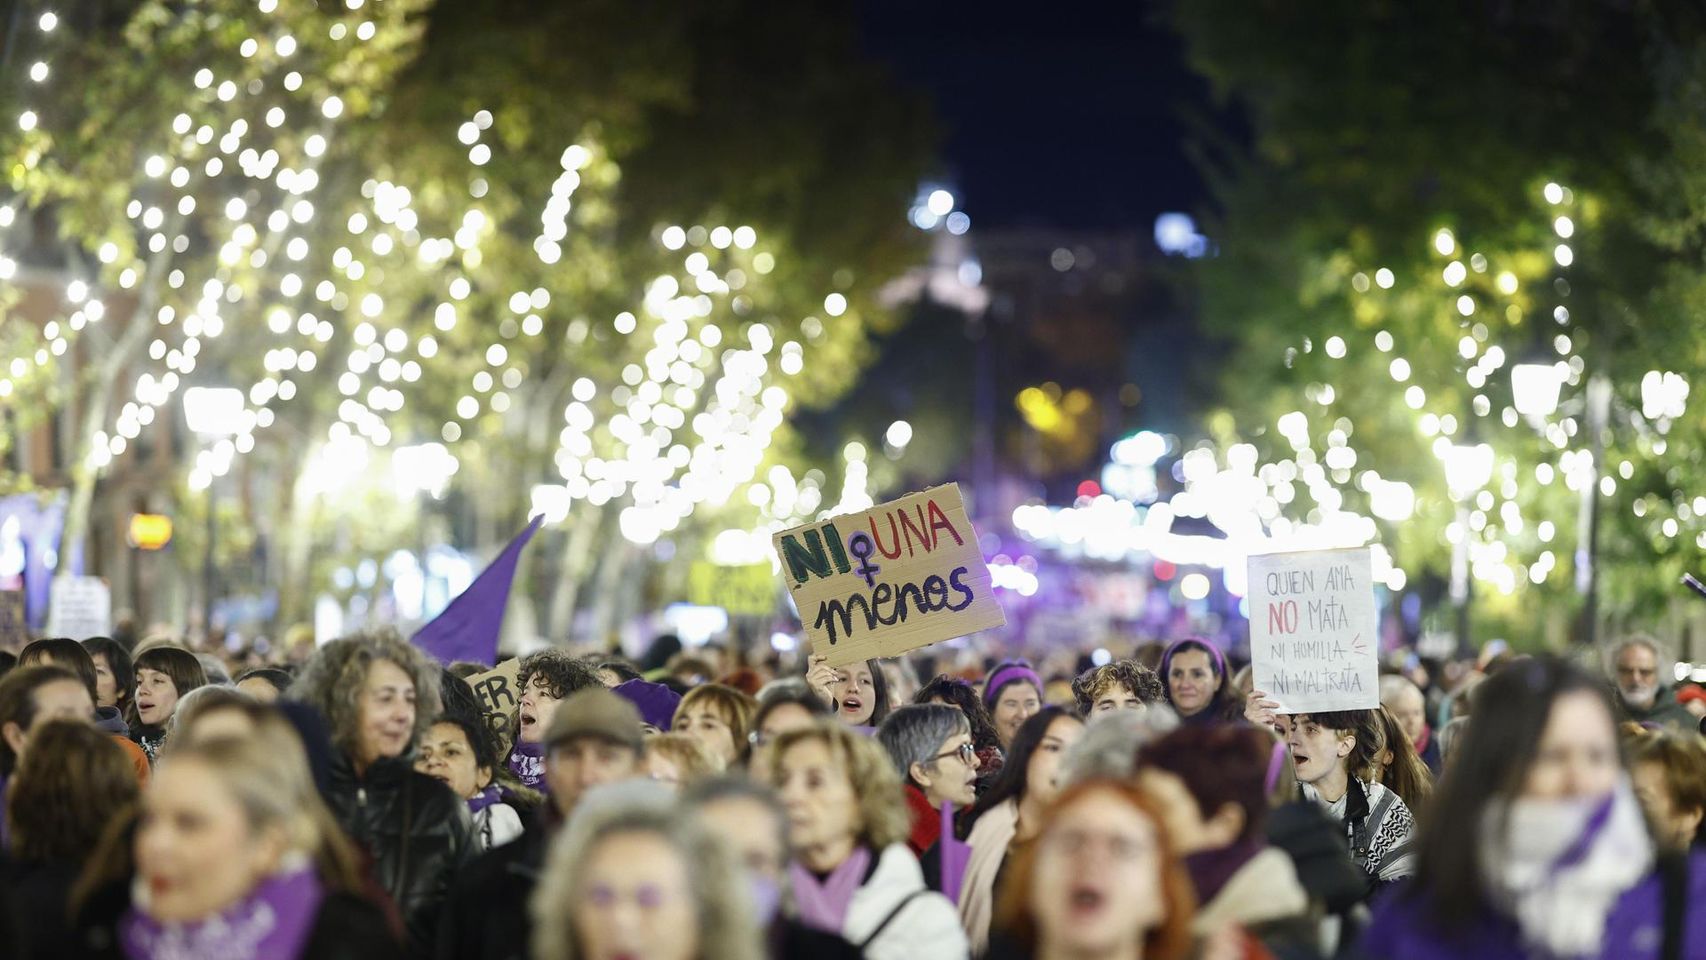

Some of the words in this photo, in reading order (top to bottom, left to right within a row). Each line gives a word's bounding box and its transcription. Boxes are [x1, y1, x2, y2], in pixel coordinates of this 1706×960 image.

[780, 522, 851, 583] NI
[868, 499, 965, 560] UNA
[1266, 569, 1315, 597] QUIEN
[1324, 564, 1356, 592] AMA
[813, 566, 975, 646] menos
[1268, 599, 1299, 635] NO
[1270, 641, 1286, 662] NI
[1293, 639, 1349, 663] HUMILLA
[1272, 667, 1290, 696] NI
[1294, 662, 1362, 696] MALTRATA
